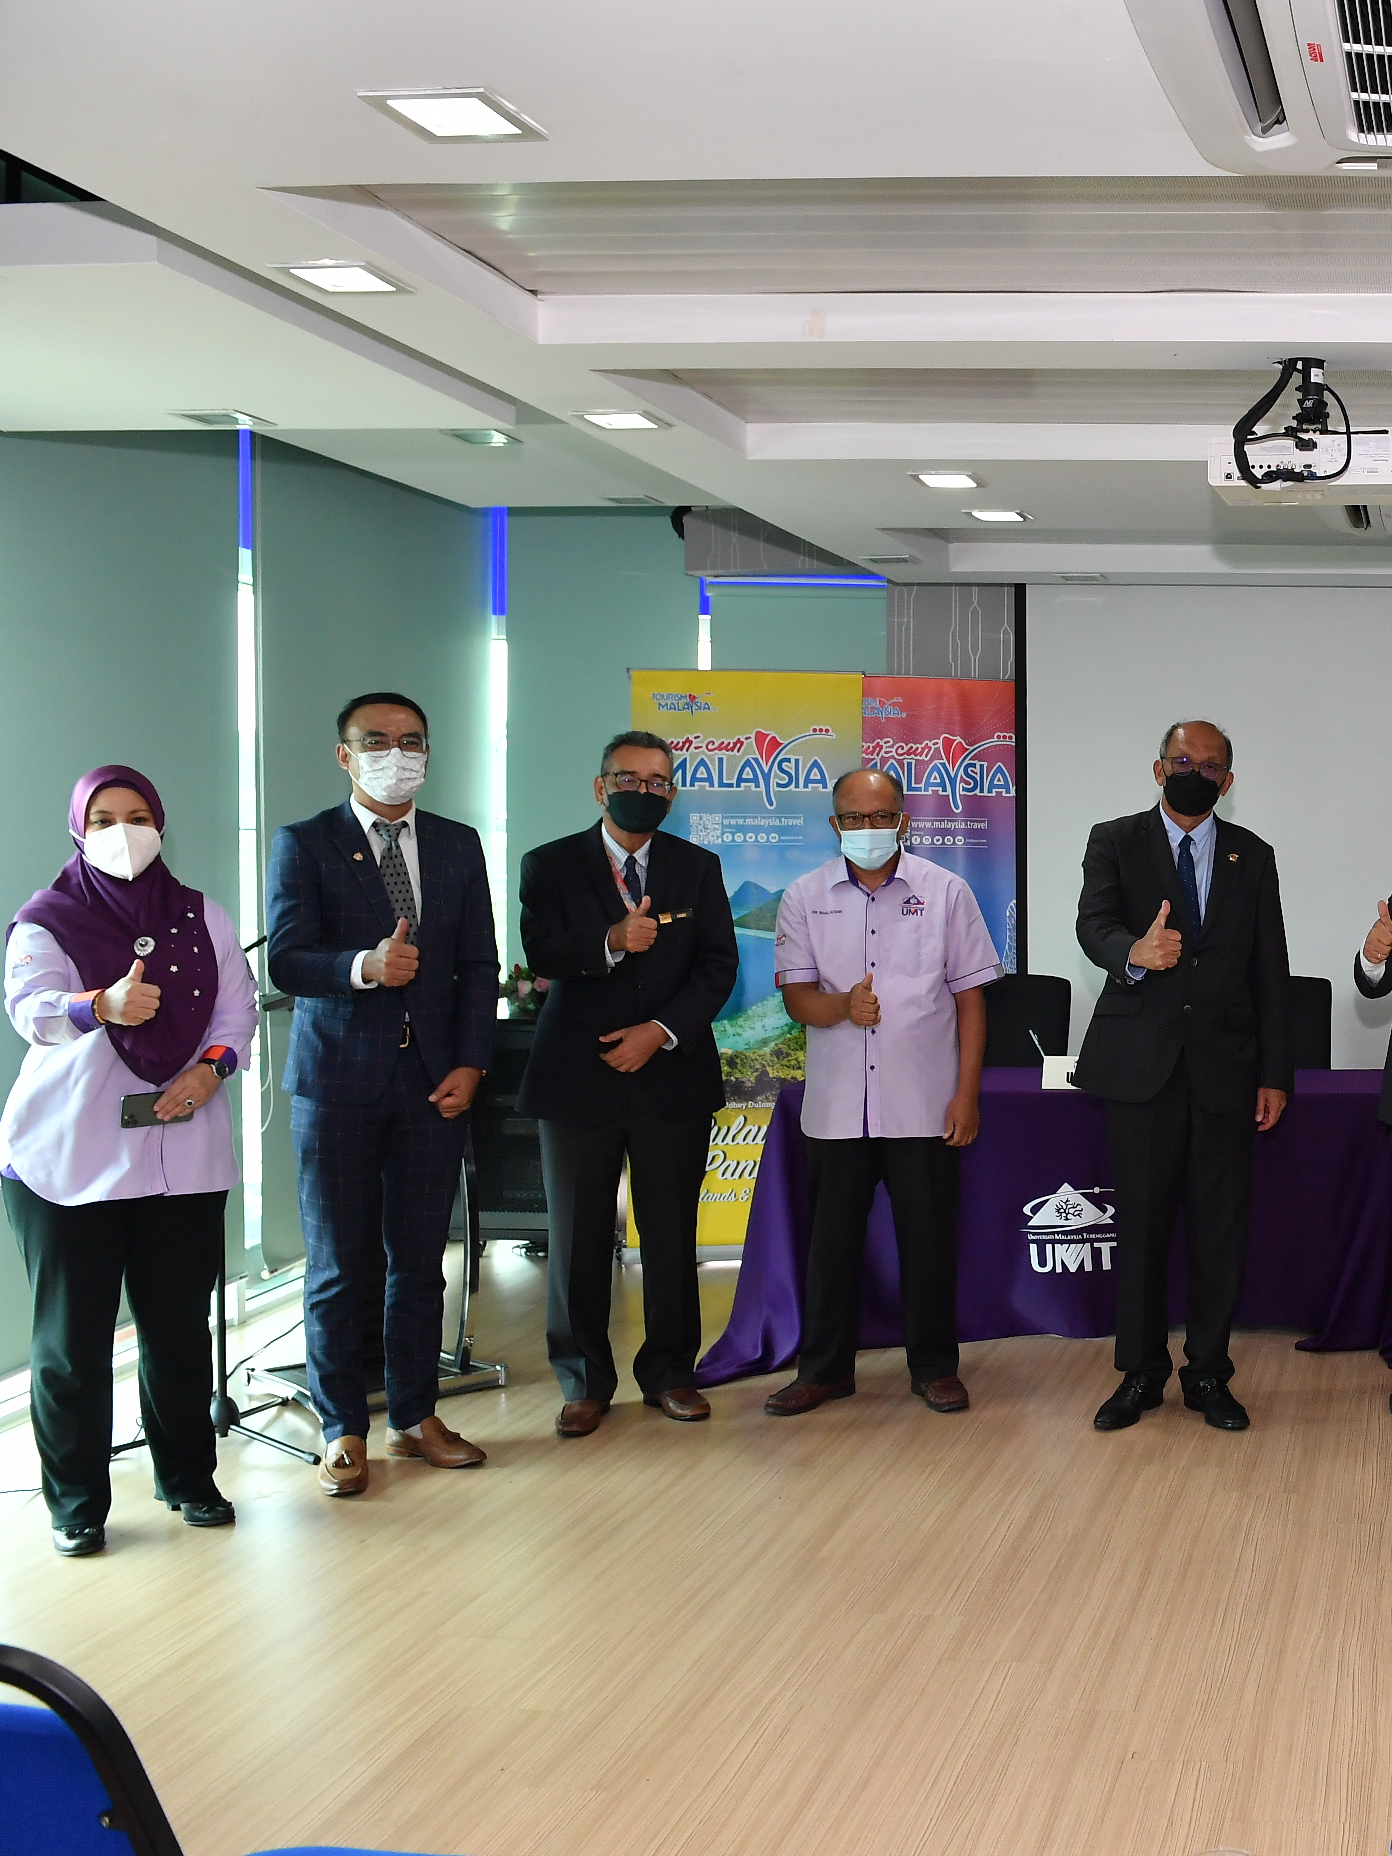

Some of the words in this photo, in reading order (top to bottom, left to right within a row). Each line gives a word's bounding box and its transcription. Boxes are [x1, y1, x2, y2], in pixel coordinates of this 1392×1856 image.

[652, 693, 688, 701] TOURISM
[658, 701, 711, 716] MALAYSIA
[668, 735, 752, 753] uti-cuti
[862, 737, 939, 758] uti-cuti
[723, 817, 804, 827] www.malaysia.travel
[911, 820, 988, 830] www.malaysia.travel
[1029, 1242, 1118, 1273] UMT
